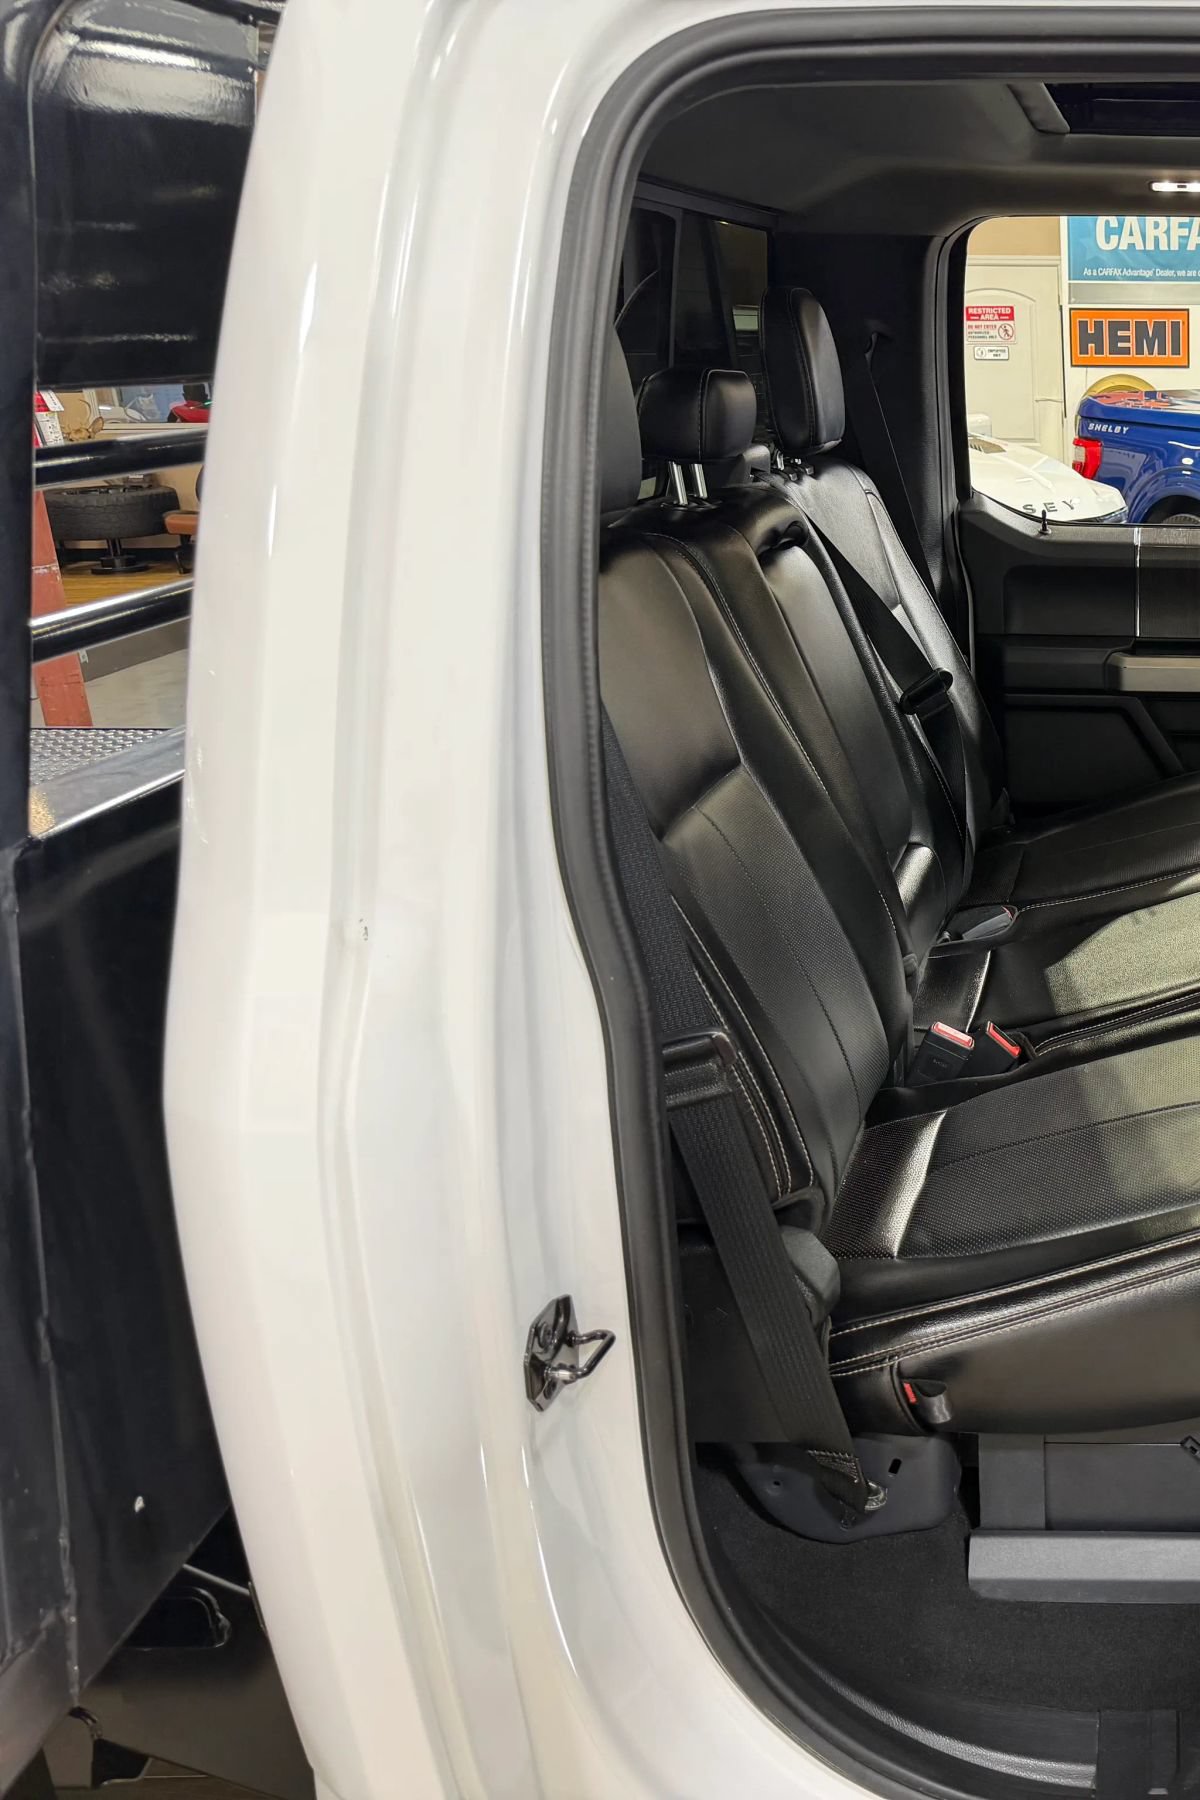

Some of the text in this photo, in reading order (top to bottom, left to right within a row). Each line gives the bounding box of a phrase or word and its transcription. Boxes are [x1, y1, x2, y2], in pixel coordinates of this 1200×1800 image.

[1083, 267, 1092, 276] As
[1098, 267, 1122, 277] CARFAX
[1077, 319, 1182, 357] HEMI
[1088, 422, 1129, 434] SHELBY
[1022, 500, 1075, 514] SEY
